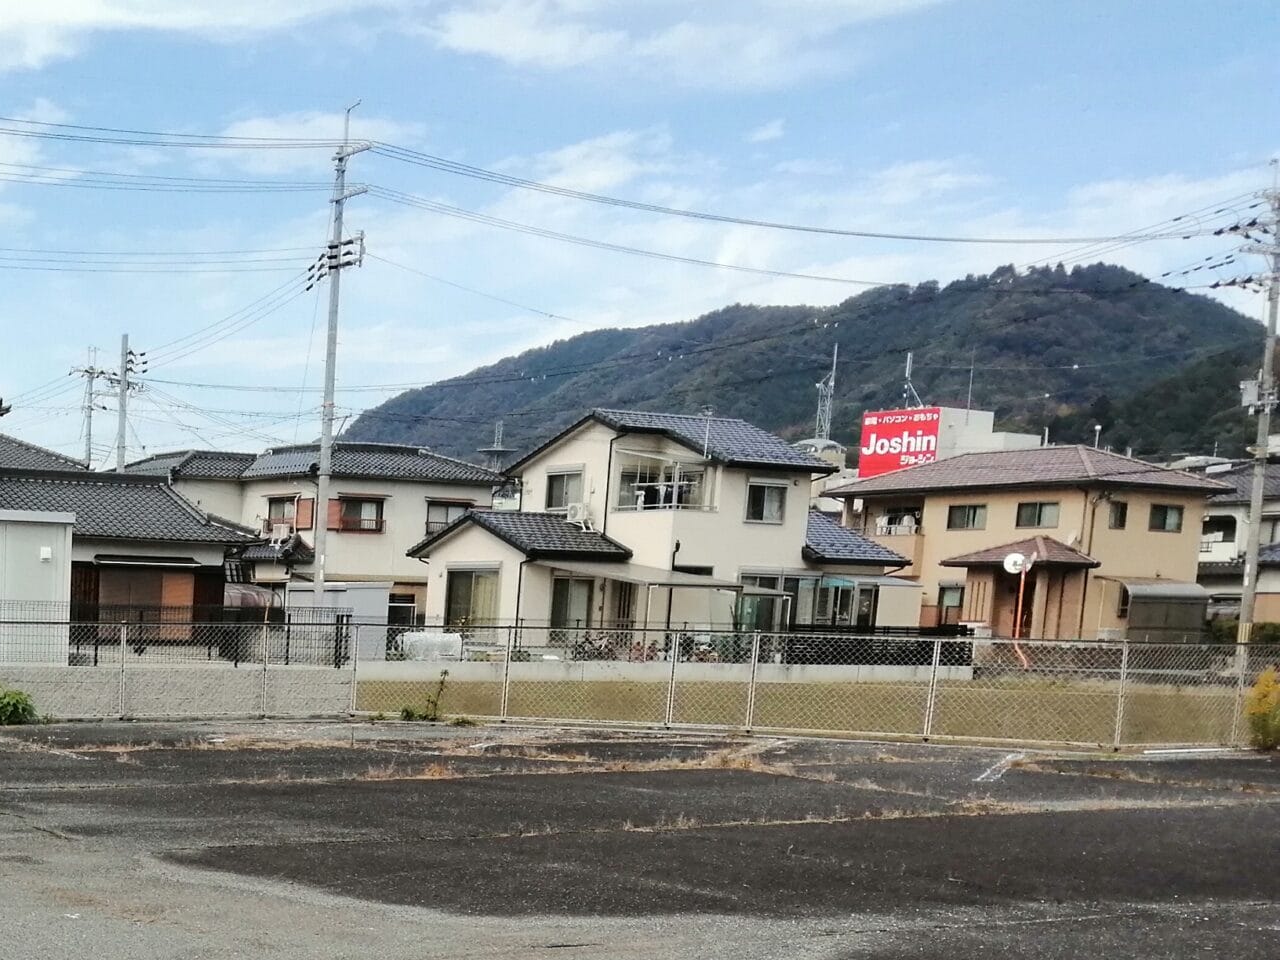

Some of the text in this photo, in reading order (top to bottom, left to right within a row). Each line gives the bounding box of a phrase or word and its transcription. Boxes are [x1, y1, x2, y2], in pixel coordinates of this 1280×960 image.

[861, 430, 936, 455] Joshin
[900, 454, 935, 465] ジョーシン
